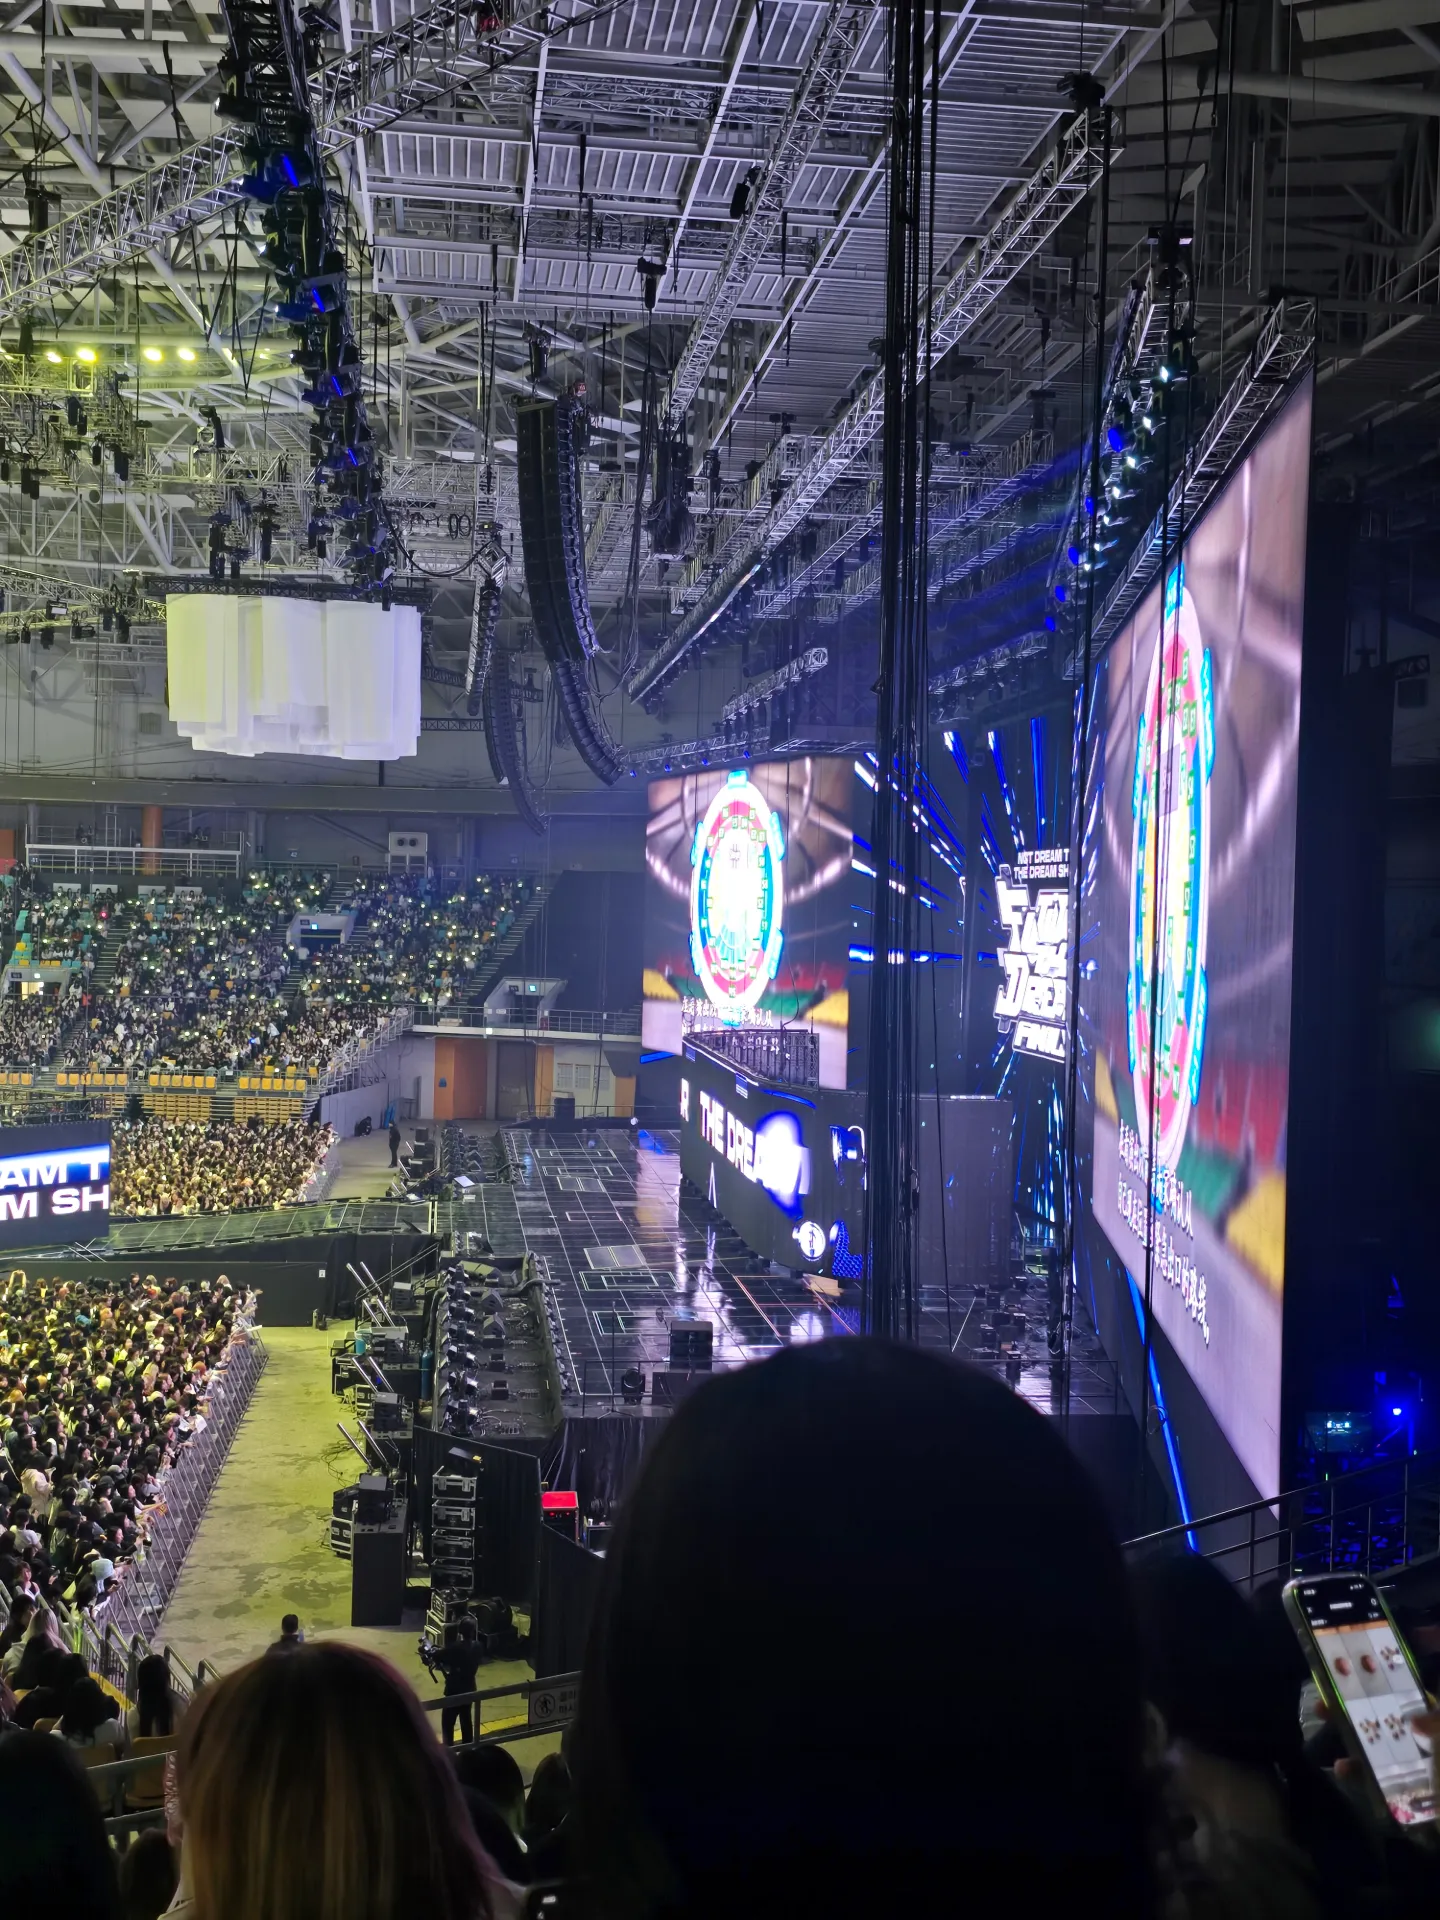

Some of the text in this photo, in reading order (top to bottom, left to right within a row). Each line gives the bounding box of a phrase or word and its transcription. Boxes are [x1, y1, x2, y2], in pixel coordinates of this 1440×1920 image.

[1034, 850, 1063, 863] DREAM
[1014, 867, 1028, 879] THE
[1029, 865, 1057, 878] DREAM
[699, 1090, 724, 1155] THE
[726, 1110, 810, 1196] DREA
